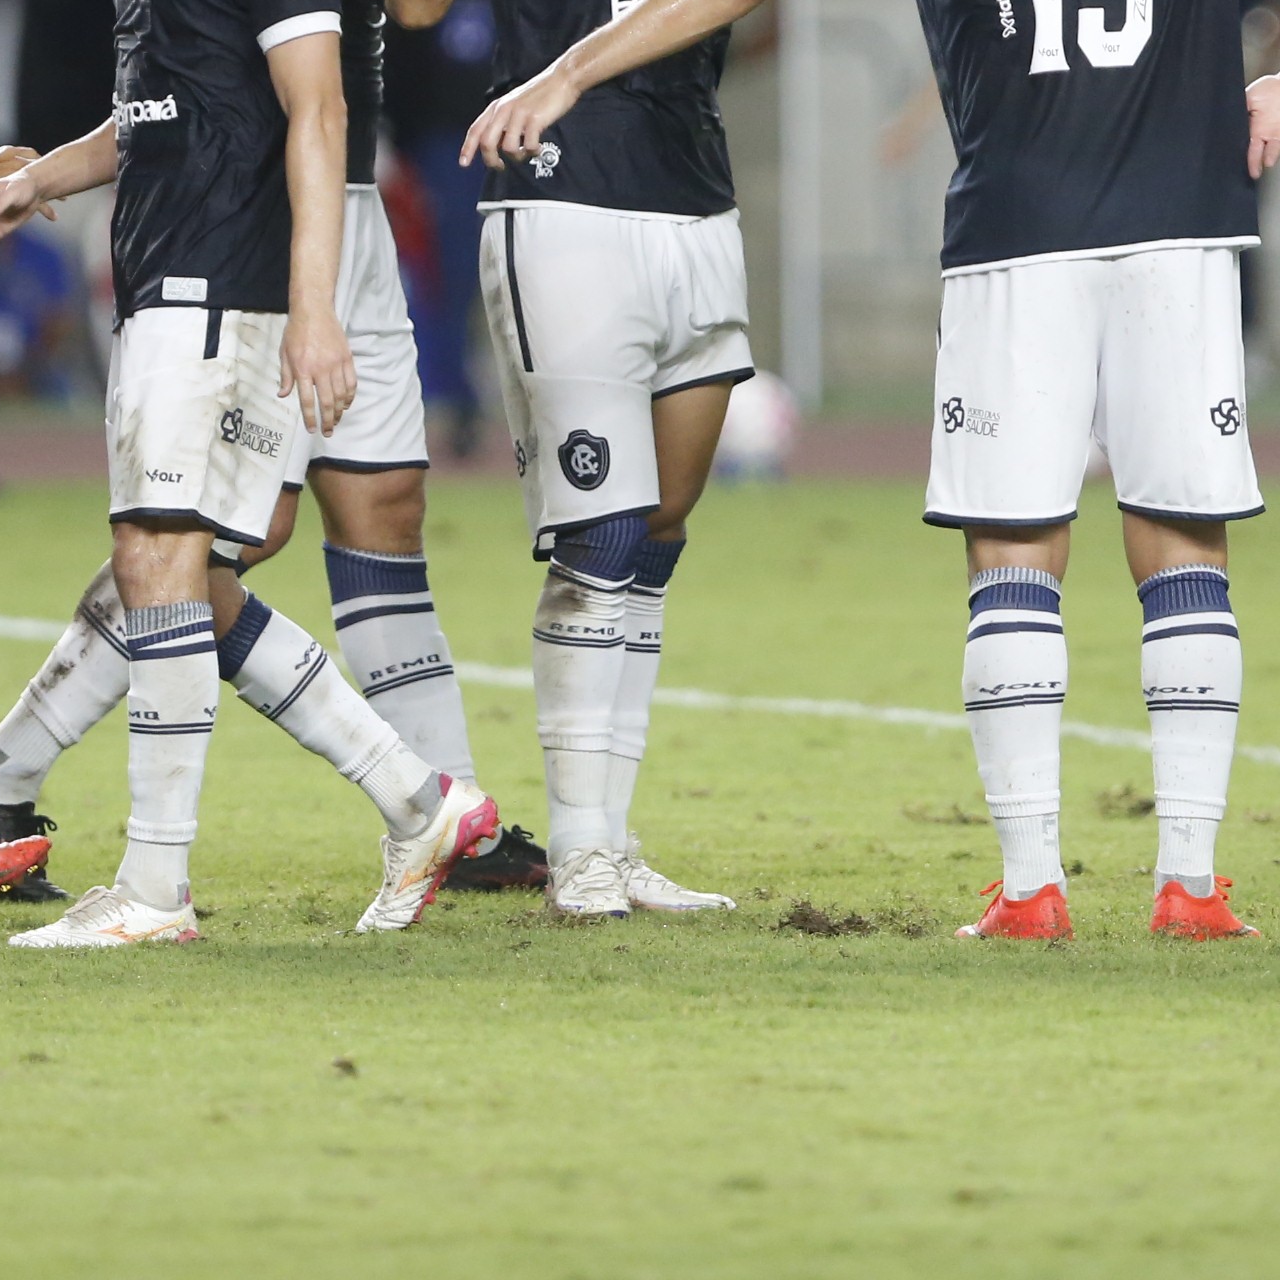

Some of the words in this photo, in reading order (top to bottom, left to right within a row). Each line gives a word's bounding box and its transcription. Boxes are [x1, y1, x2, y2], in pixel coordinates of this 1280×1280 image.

[965, 418, 999, 438] SAÚDE
[240, 431, 281, 458] SAÚDE
[146, 469, 183, 484] VOLT
[550, 622, 616, 636] REMO
[639, 631, 662, 640] RE
[370, 653, 442, 681] REMO
[979, 680, 1062, 695] VOLT
[128, 710, 160, 721] MO
